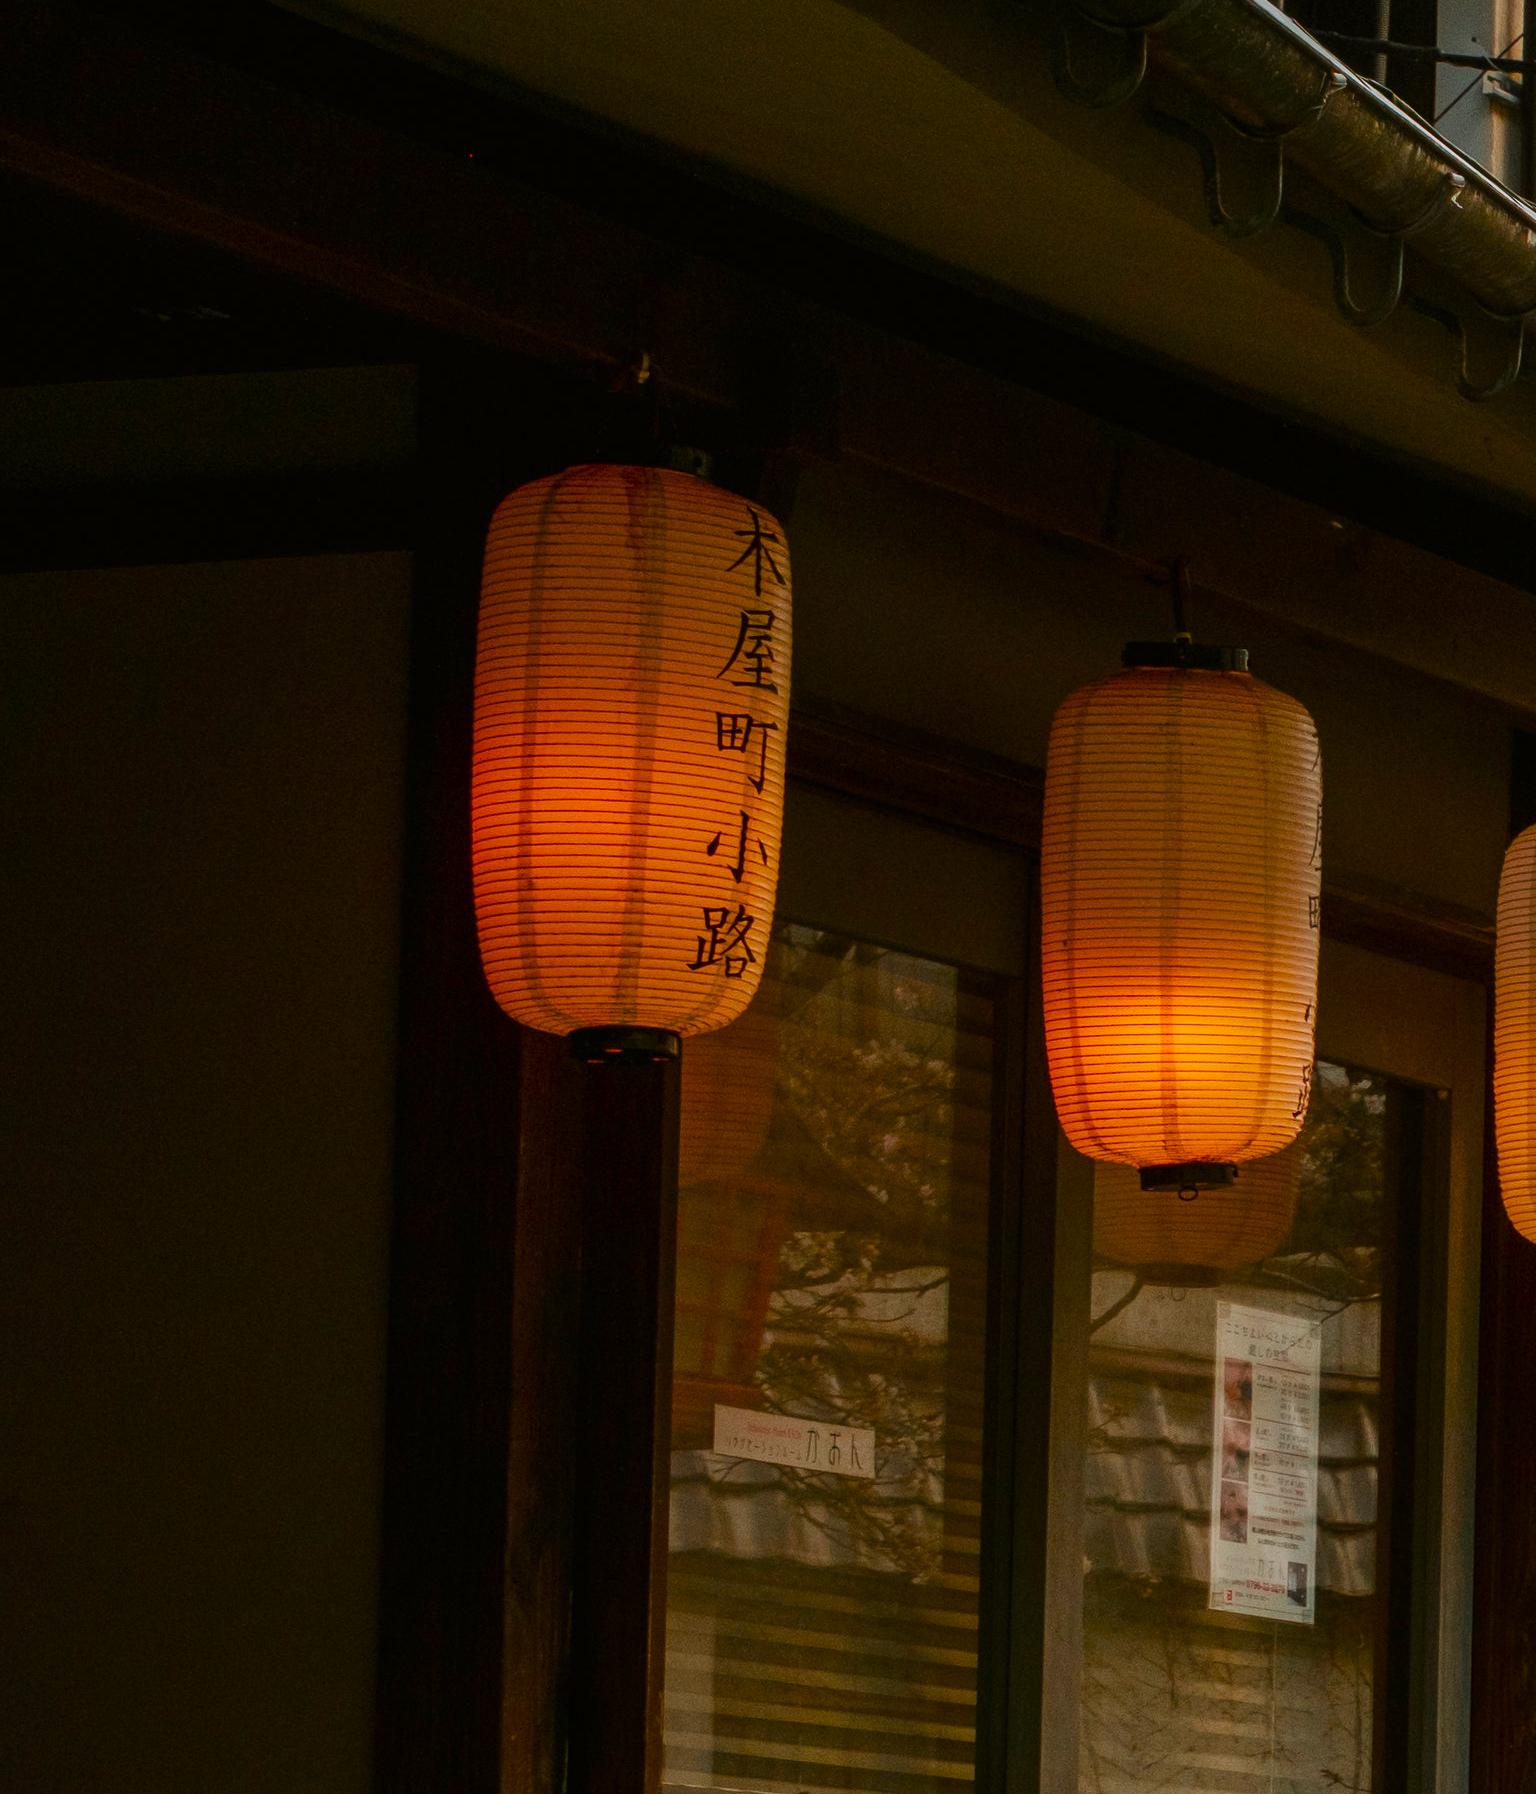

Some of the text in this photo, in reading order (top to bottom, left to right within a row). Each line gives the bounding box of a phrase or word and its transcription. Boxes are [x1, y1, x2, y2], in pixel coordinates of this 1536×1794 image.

[686, 505, 786, 978] 木屋町小路
